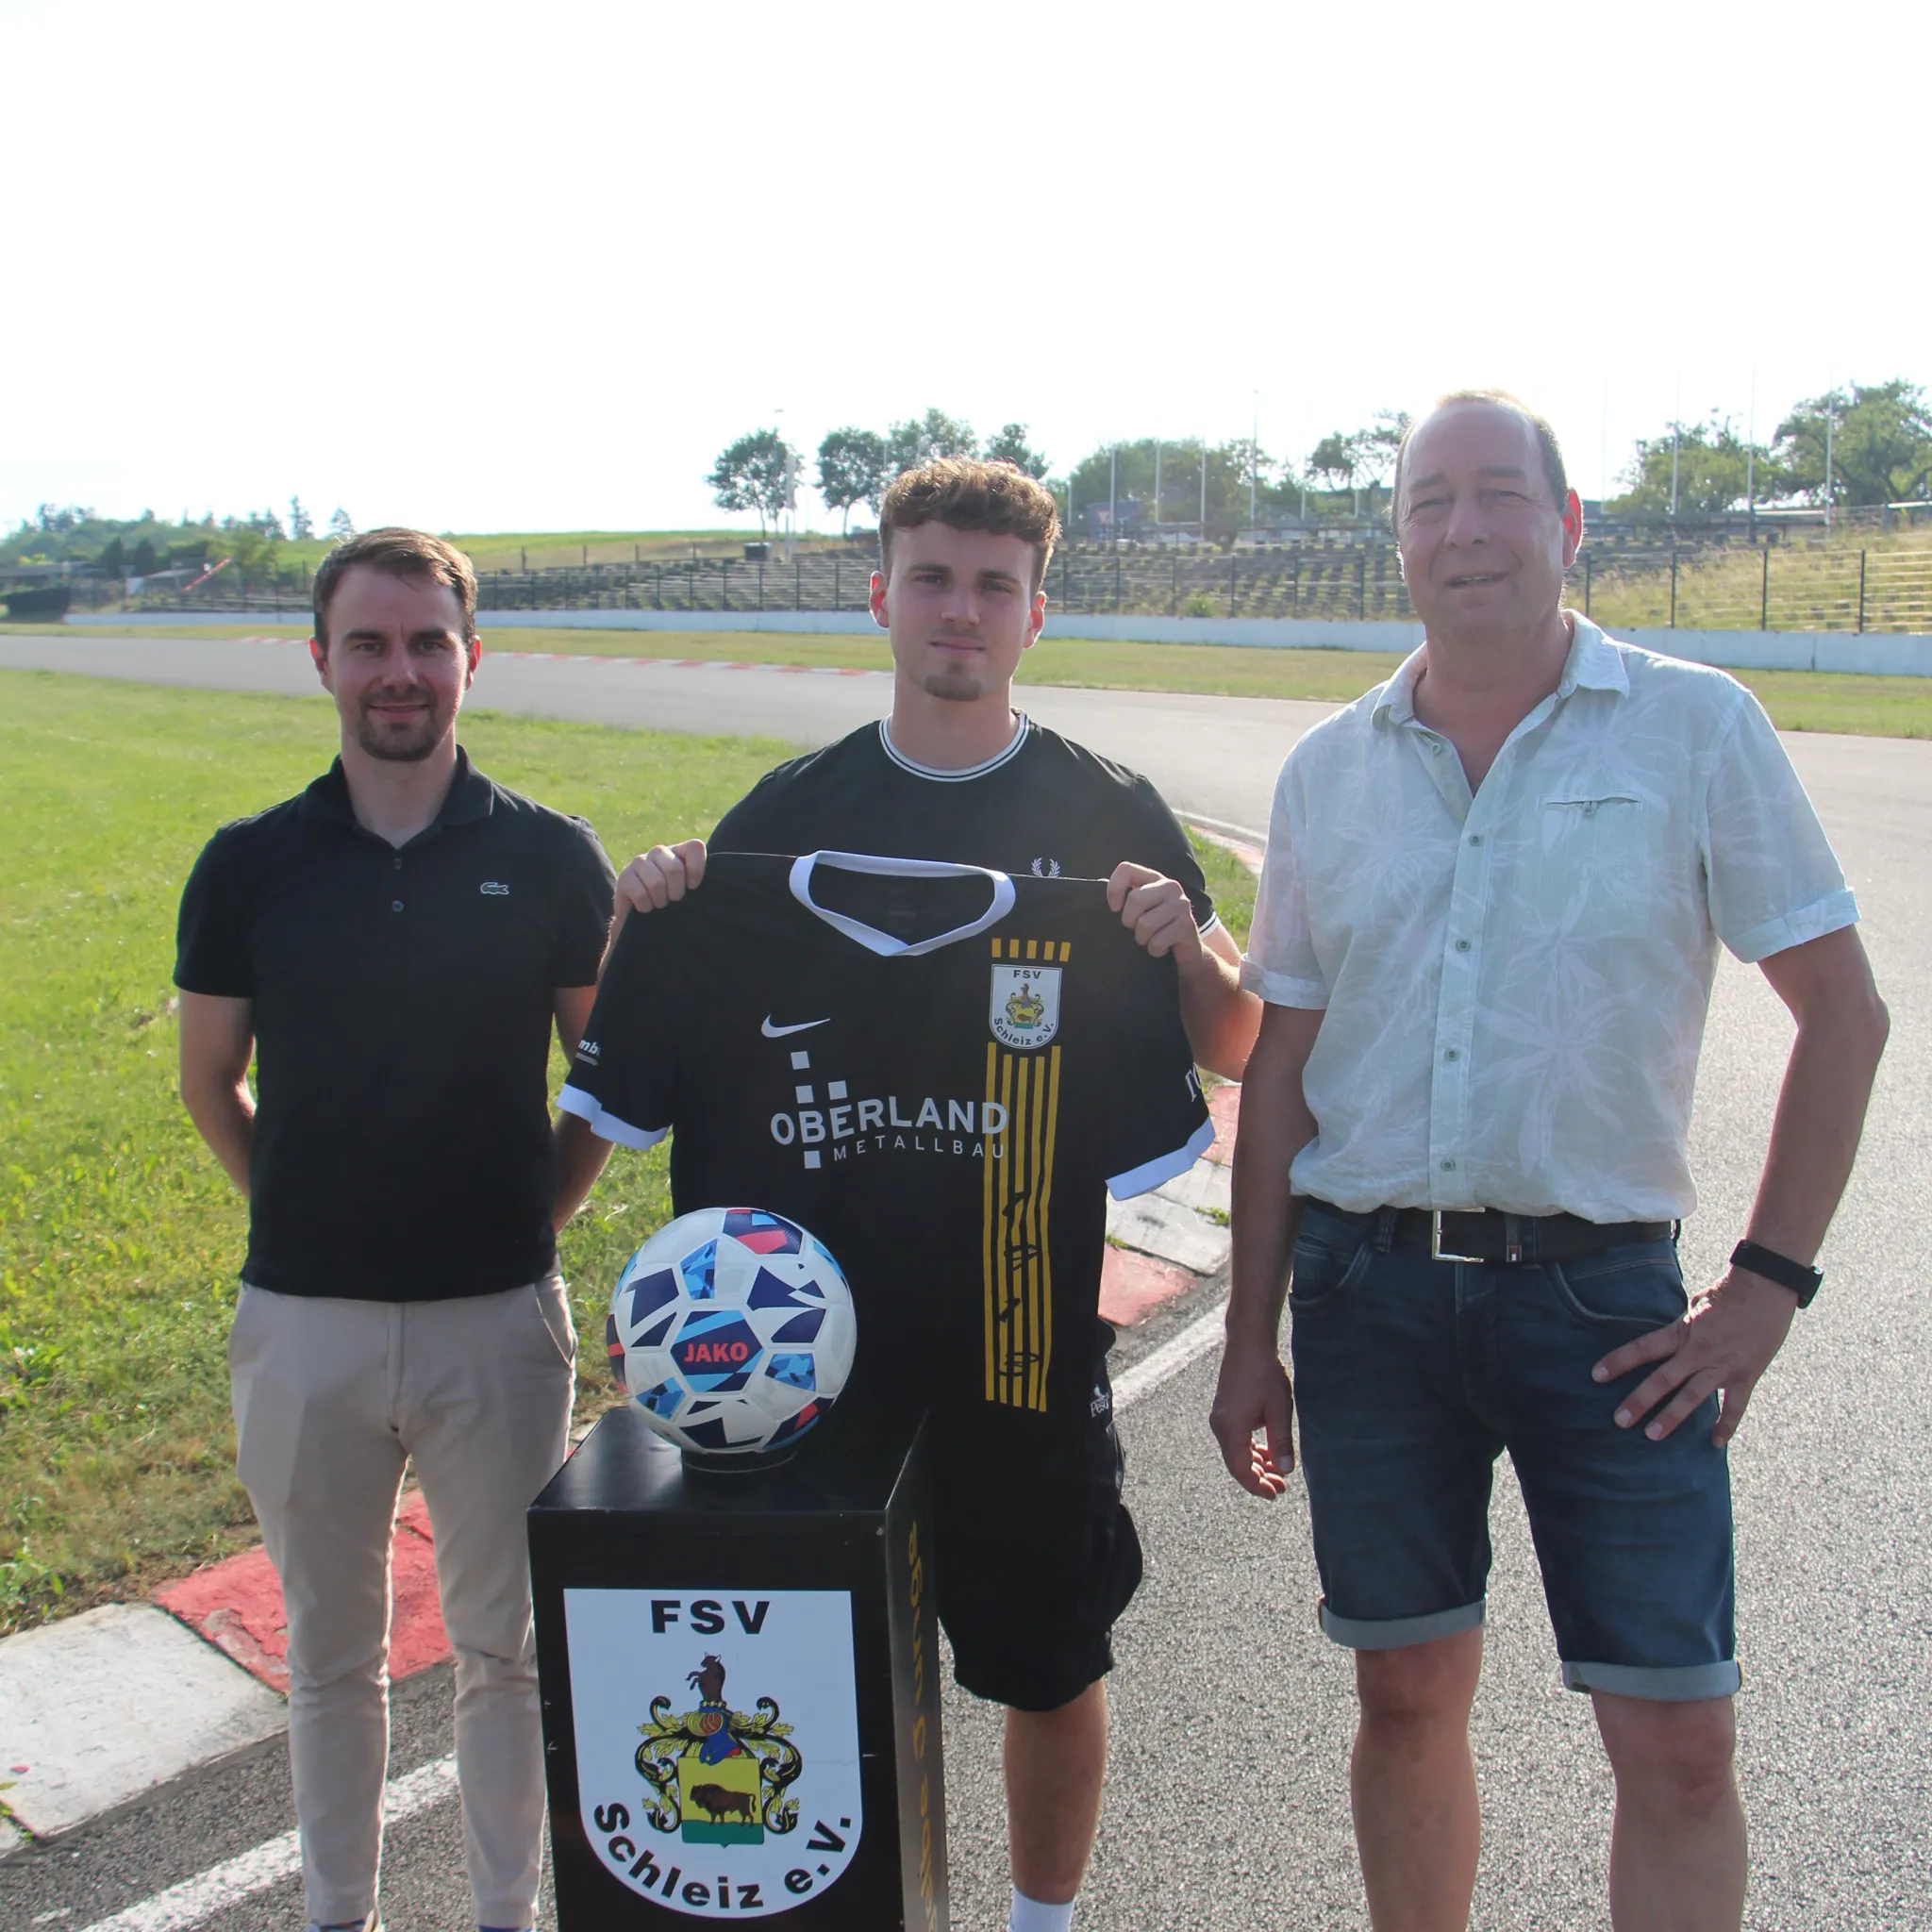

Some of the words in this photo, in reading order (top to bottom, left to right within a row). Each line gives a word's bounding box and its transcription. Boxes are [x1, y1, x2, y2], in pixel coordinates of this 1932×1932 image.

[1013, 969, 1041, 979] FSV
[993, 1017, 1032, 1046] Schleiz
[1036, 1023, 1054, 1042] e.V.
[770, 1095, 1010, 1145] OBERLAND
[833, 1135, 1005, 1162] METALLBAU
[683, 1341, 749, 1363] JAKO
[650, 1599, 772, 1635] FSV
[593, 1802, 764, 1909] Schleiz
[783, 1817, 852, 1894] e.V.
